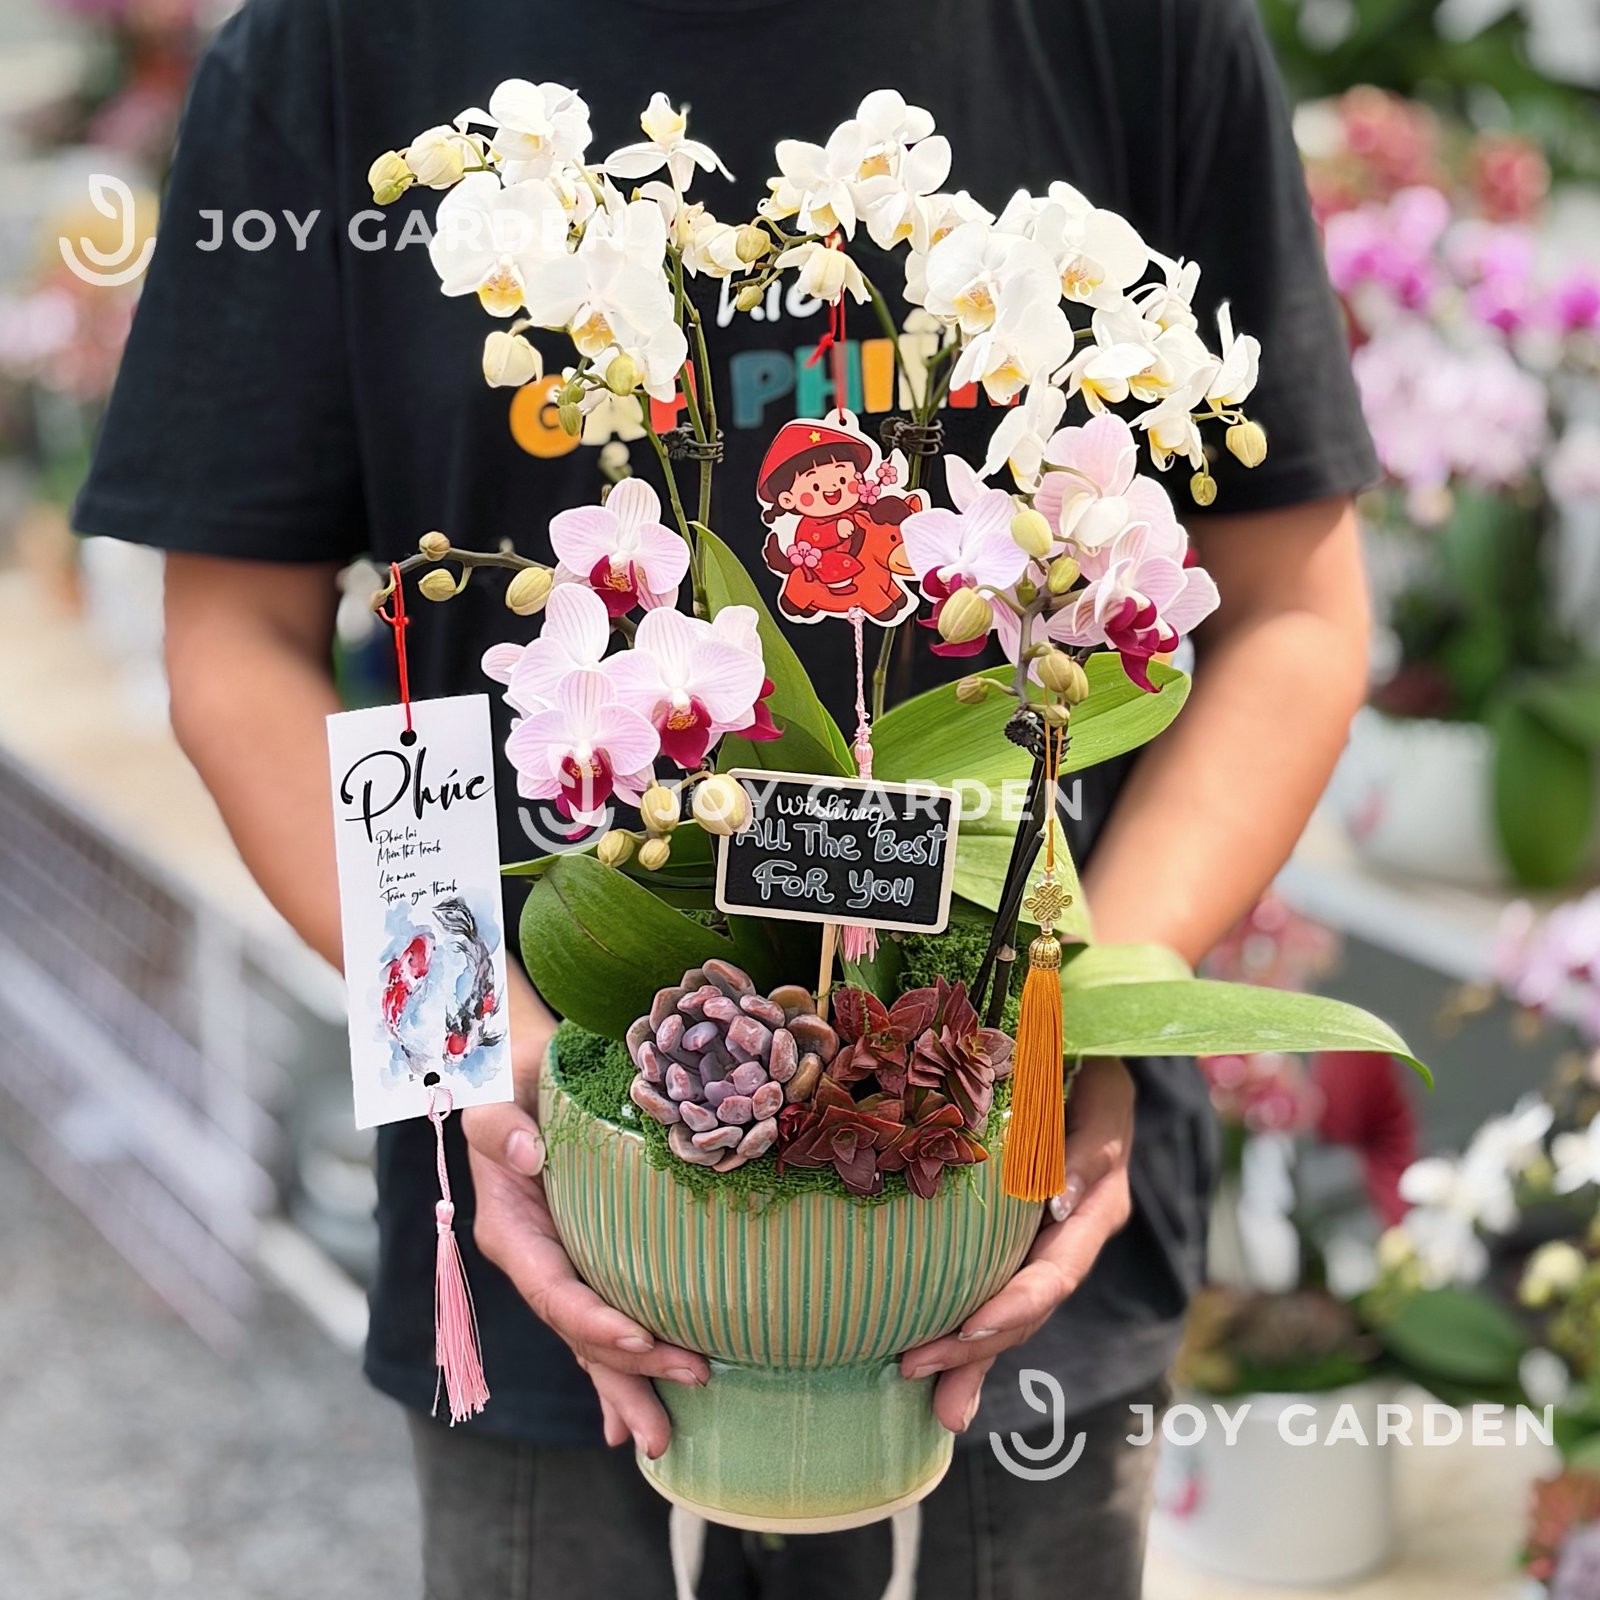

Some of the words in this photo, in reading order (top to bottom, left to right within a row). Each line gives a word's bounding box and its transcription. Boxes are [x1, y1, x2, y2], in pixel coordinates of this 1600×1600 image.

[340, 746, 493, 843] Phúc
[776, 793, 895, 838] Wishing
[793, 820, 861, 861] The
